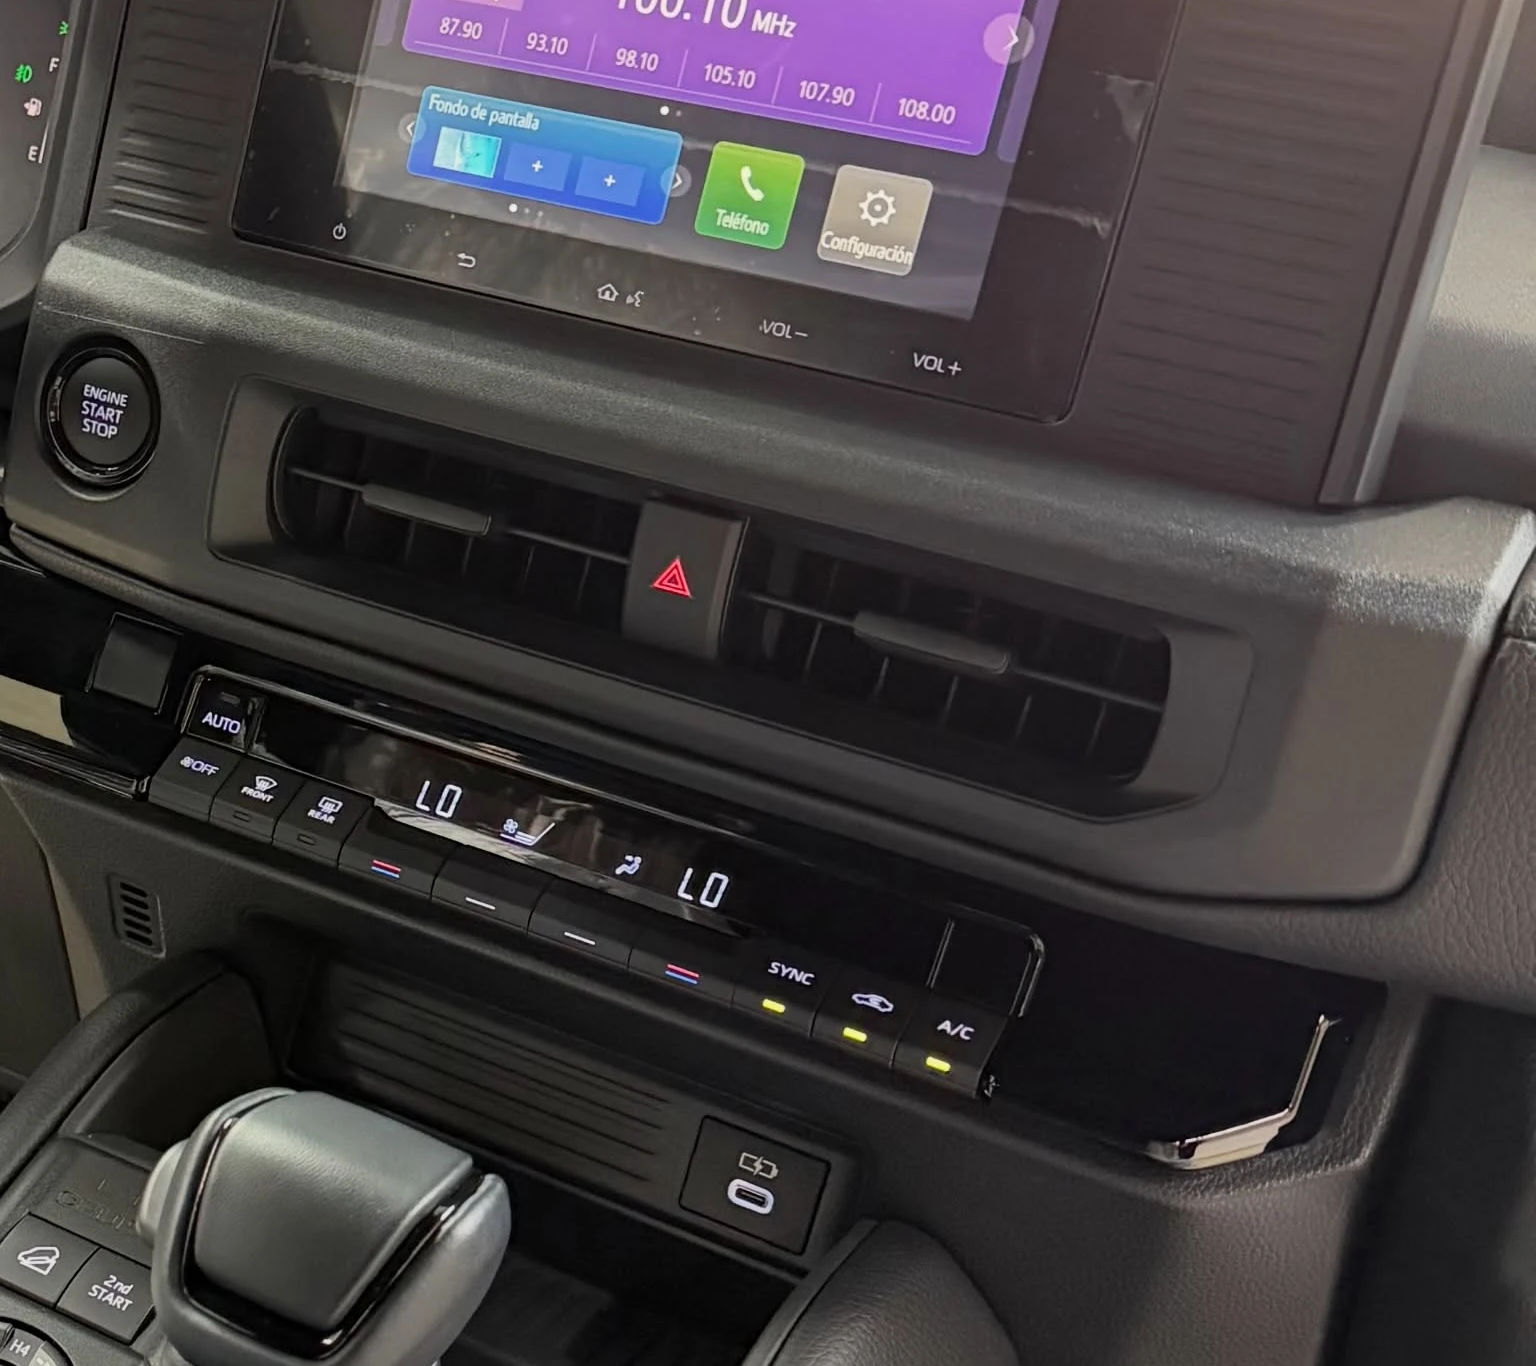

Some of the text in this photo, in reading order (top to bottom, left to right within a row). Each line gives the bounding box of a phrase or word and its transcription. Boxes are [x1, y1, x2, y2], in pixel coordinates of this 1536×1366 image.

[751, 9, 799, 38] MHz
[49, 57, 60, 72] F
[439, 17, 956, 125] 87.90 93.10 98.10 105.10 107.90 108.00
[428, 93, 540, 131] Fondo de pantalla
[28, 146, 39, 161] E
[716, 209, 770, 236] Teléfono
[821, 230, 914, 266] Configuración
[83, 384, 128, 407] ENGINE
[81, 400, 123, 424] START
[81, 418, 118, 439] STOP
[201, 711, 241, 734] AUTO
[191, 760, 220, 776] OFF
[240, 786, 274, 803] FRONT
[415, 778, 463, 820] LO
[307, 808, 336, 824] REAR
[676, 866, 730, 910] LO
[767, 960, 816, 988] SYNC
[936, 1018, 976, 1042] A/C
[103, 1274, 134, 1295] 2nd
[87, 1284, 133, 1312] START
[9, 1339, 31, 1357] H4
